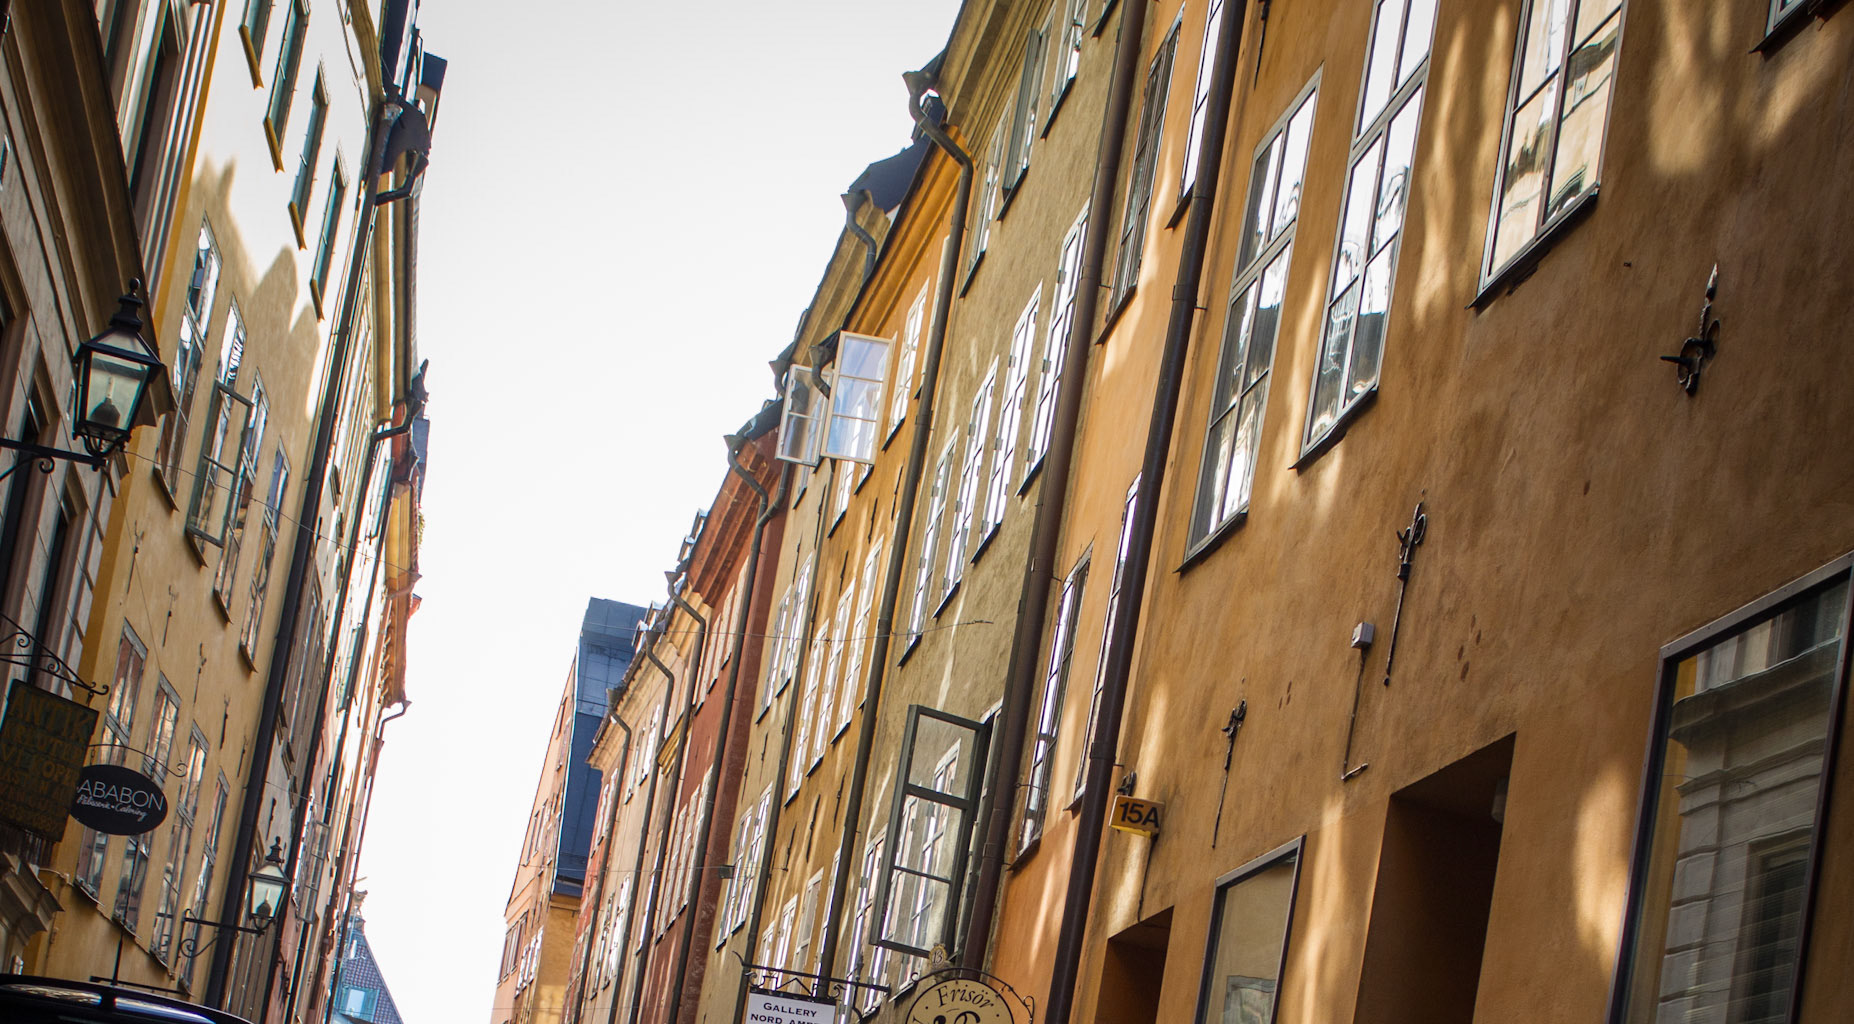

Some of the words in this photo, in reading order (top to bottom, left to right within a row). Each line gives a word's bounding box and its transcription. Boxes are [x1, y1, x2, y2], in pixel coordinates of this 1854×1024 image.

[8, 687, 95, 743] ANTIK
[76, 778, 165, 812] ABABON
[1120, 802, 1160, 828] 15A
[933, 949, 943, 964] 13
[936, 984, 994, 1007] Frisör
[750, 1014, 783, 1024] NORD
[763, 1002, 817, 1017] GALLERY
